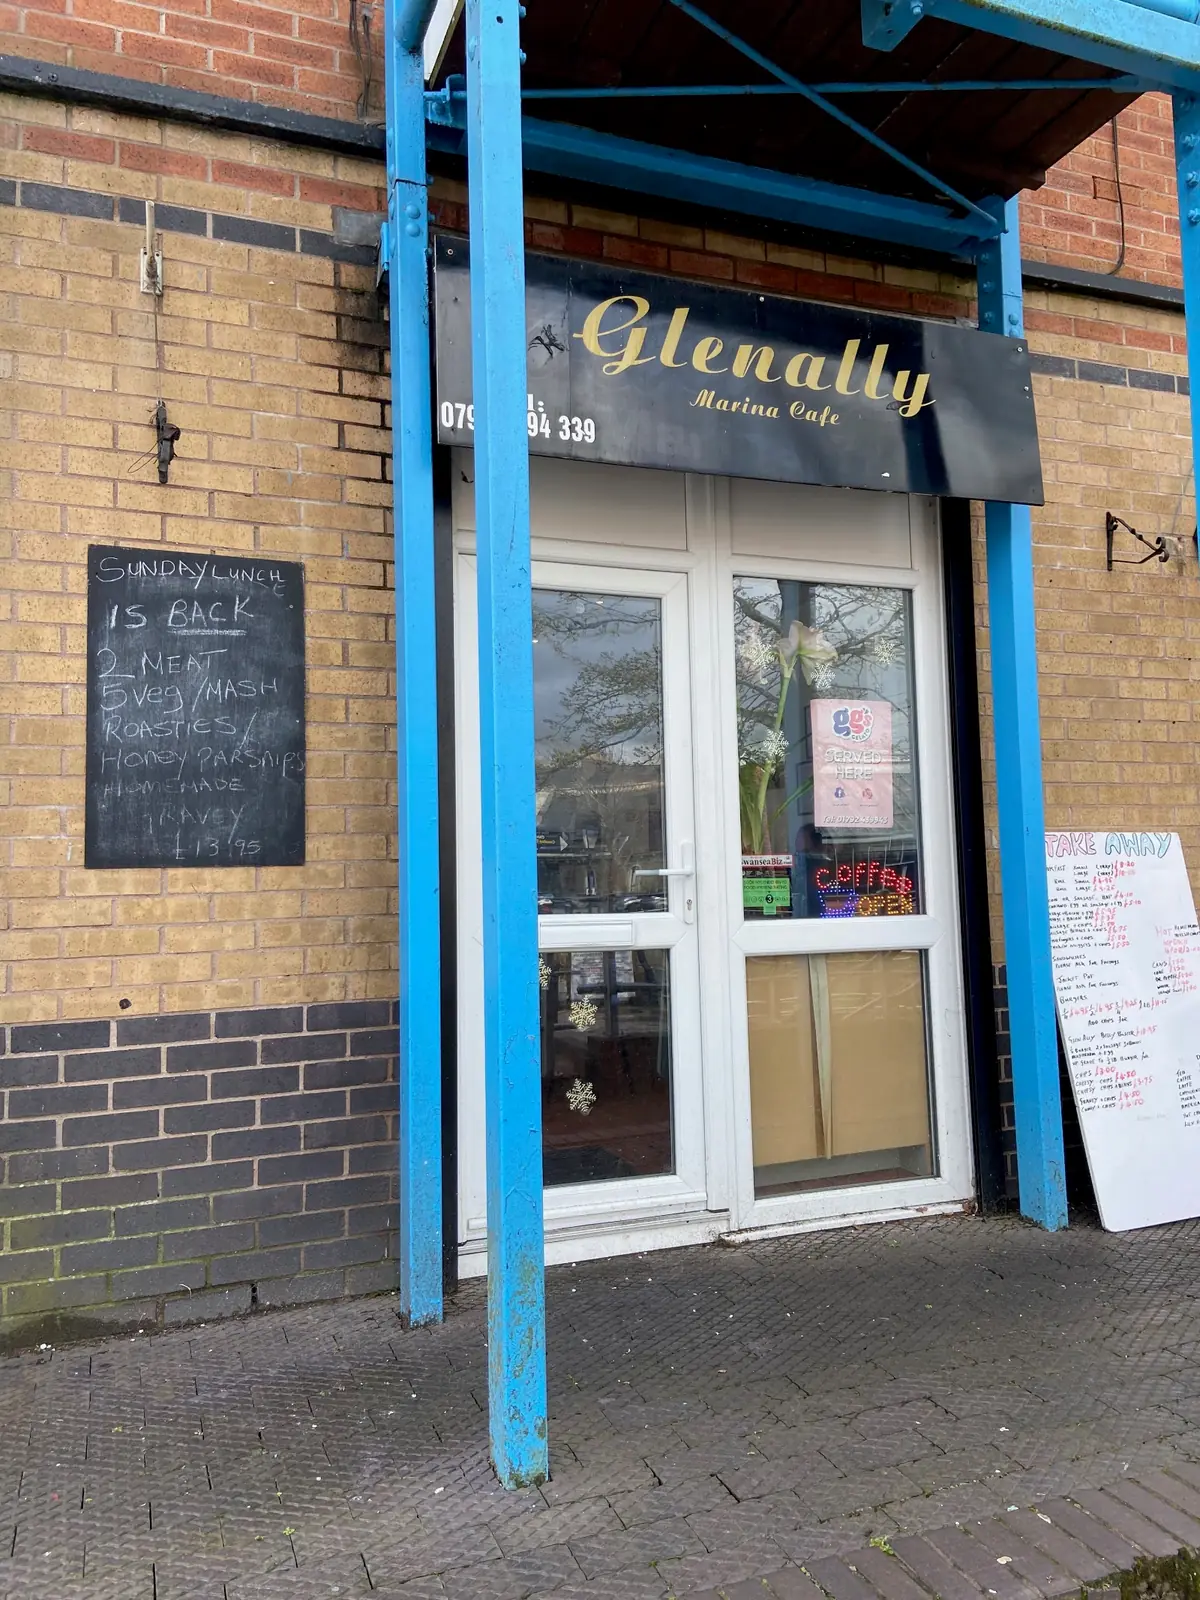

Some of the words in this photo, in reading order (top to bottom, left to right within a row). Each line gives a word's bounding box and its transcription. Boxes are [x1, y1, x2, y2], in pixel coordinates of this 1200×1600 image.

[572, 295, 936, 417] Glenally
[441, 402, 474, 430] 079
[527, 412, 551, 438] 94
[558, 415, 596, 443] 339
[690, 388, 780, 419] Marina
[789, 400, 841, 426] Cafe
[95, 556, 208, 589] SUNDAY
[109, 603, 148, 630] IS
[167, 596, 254, 629] BACK
[97, 647, 135, 678] 2
[141, 649, 228, 674] MEAT
[852, 729, 870, 740] GELATO
[825, 748, 881, 764] SERVED
[835, 766, 873, 780] HERE
[1045, 832, 1097, 858] TAKE
[1105, 832, 1171, 858] AWAY
[859, 895, 912, 916] OPEN
